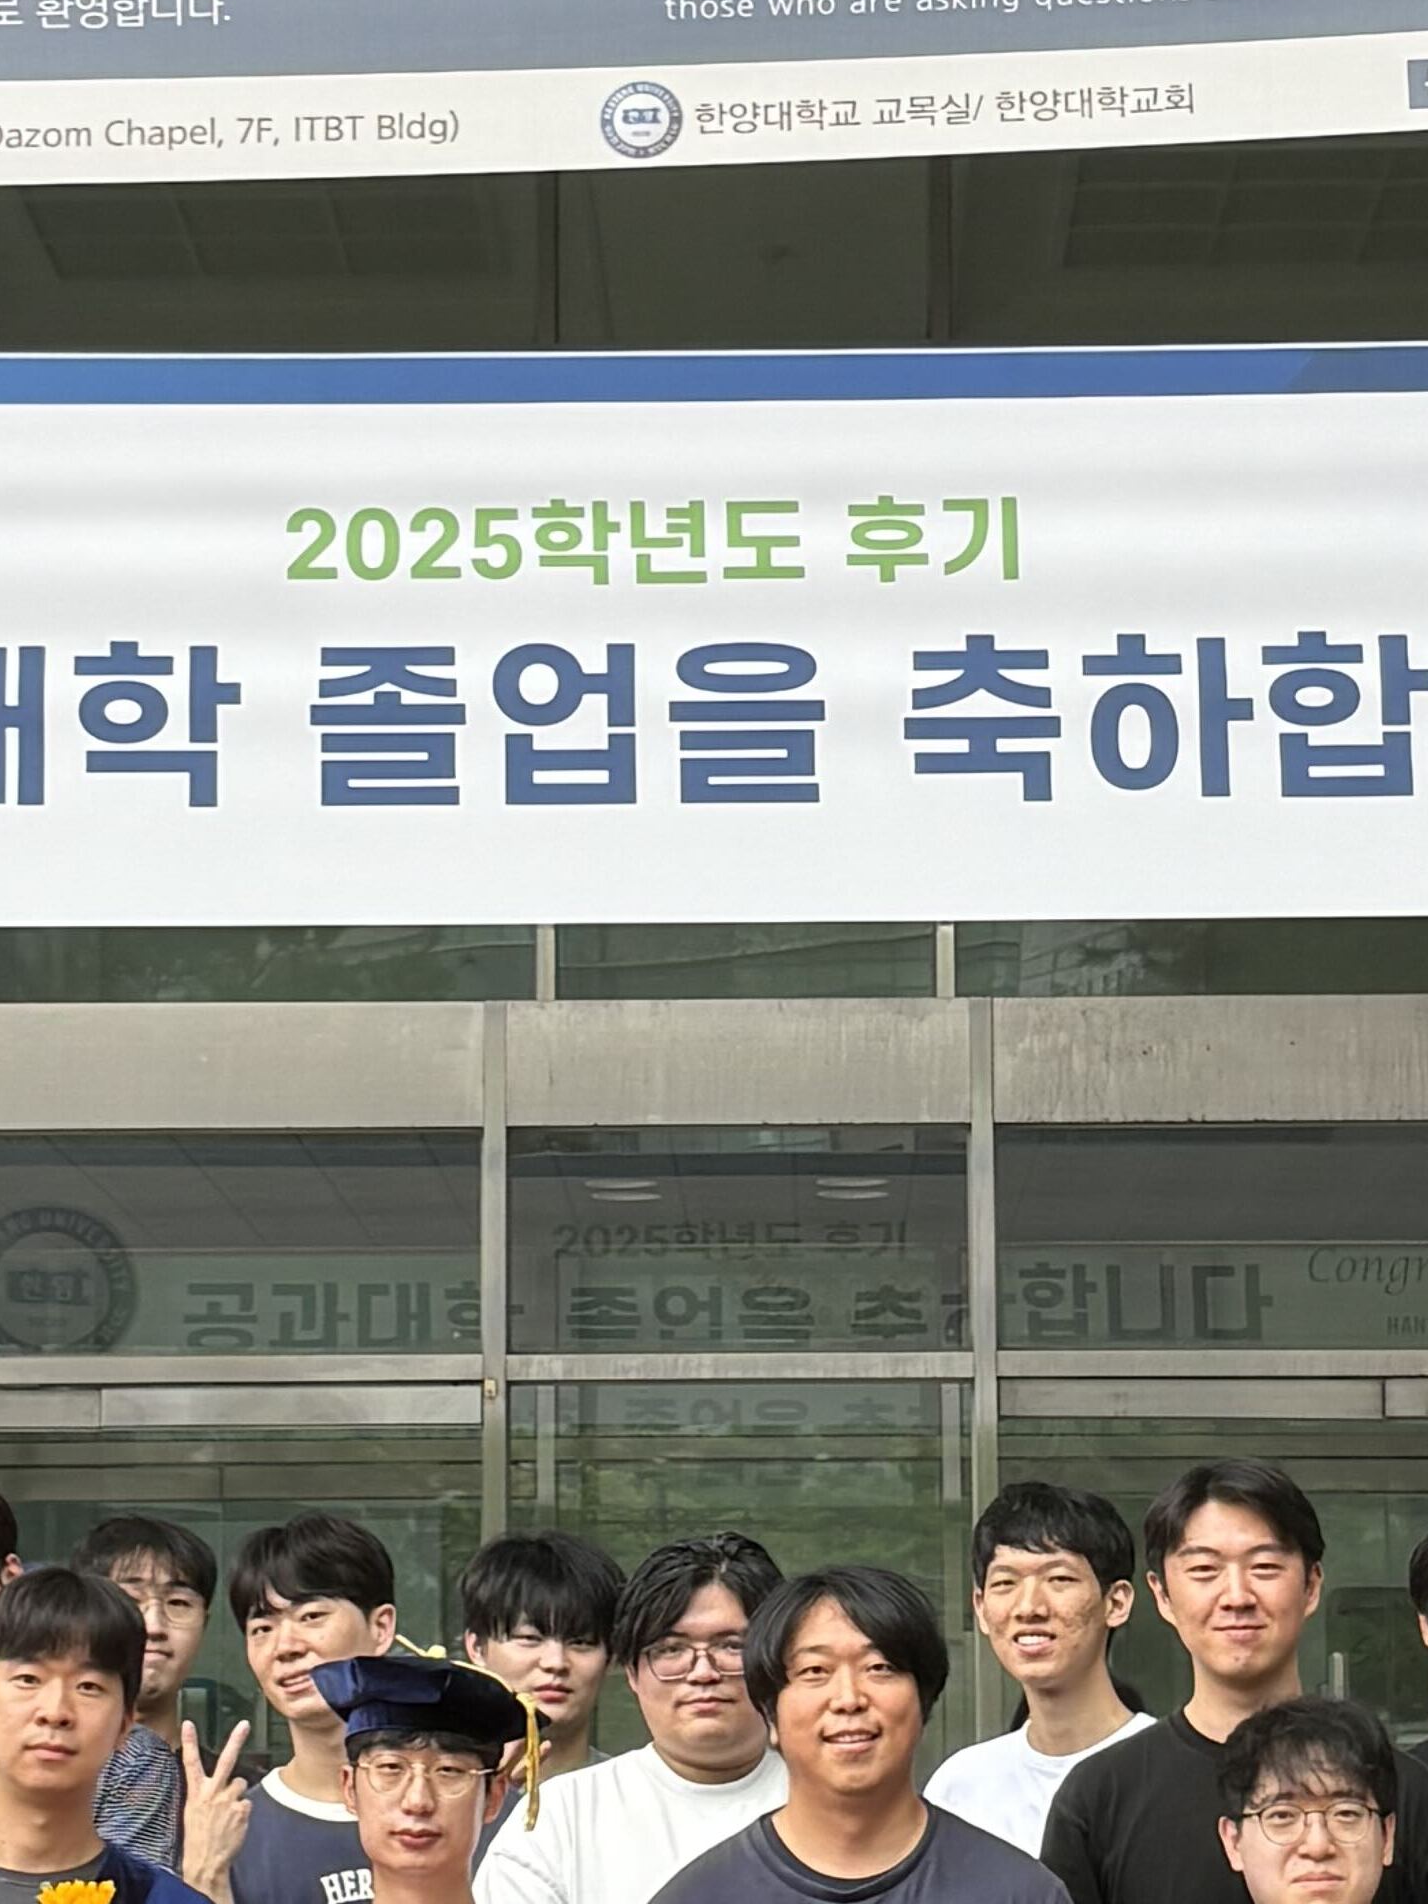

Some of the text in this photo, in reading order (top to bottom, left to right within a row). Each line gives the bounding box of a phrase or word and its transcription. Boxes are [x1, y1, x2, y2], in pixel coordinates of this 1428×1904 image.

[104, 116, 224, 151] Chapel,
[235, 117, 280, 147] 7F,
[294, 115, 365, 142] ITBT
[376, 109, 460, 145] Bldg)
[694, 98, 862, 135] 한양대학교
[995, 82, 1195, 123] 한양대학교회
[285, 494, 1020, 586] 2025학년도 후기
[309, 641, 826, 807] 졸업을
